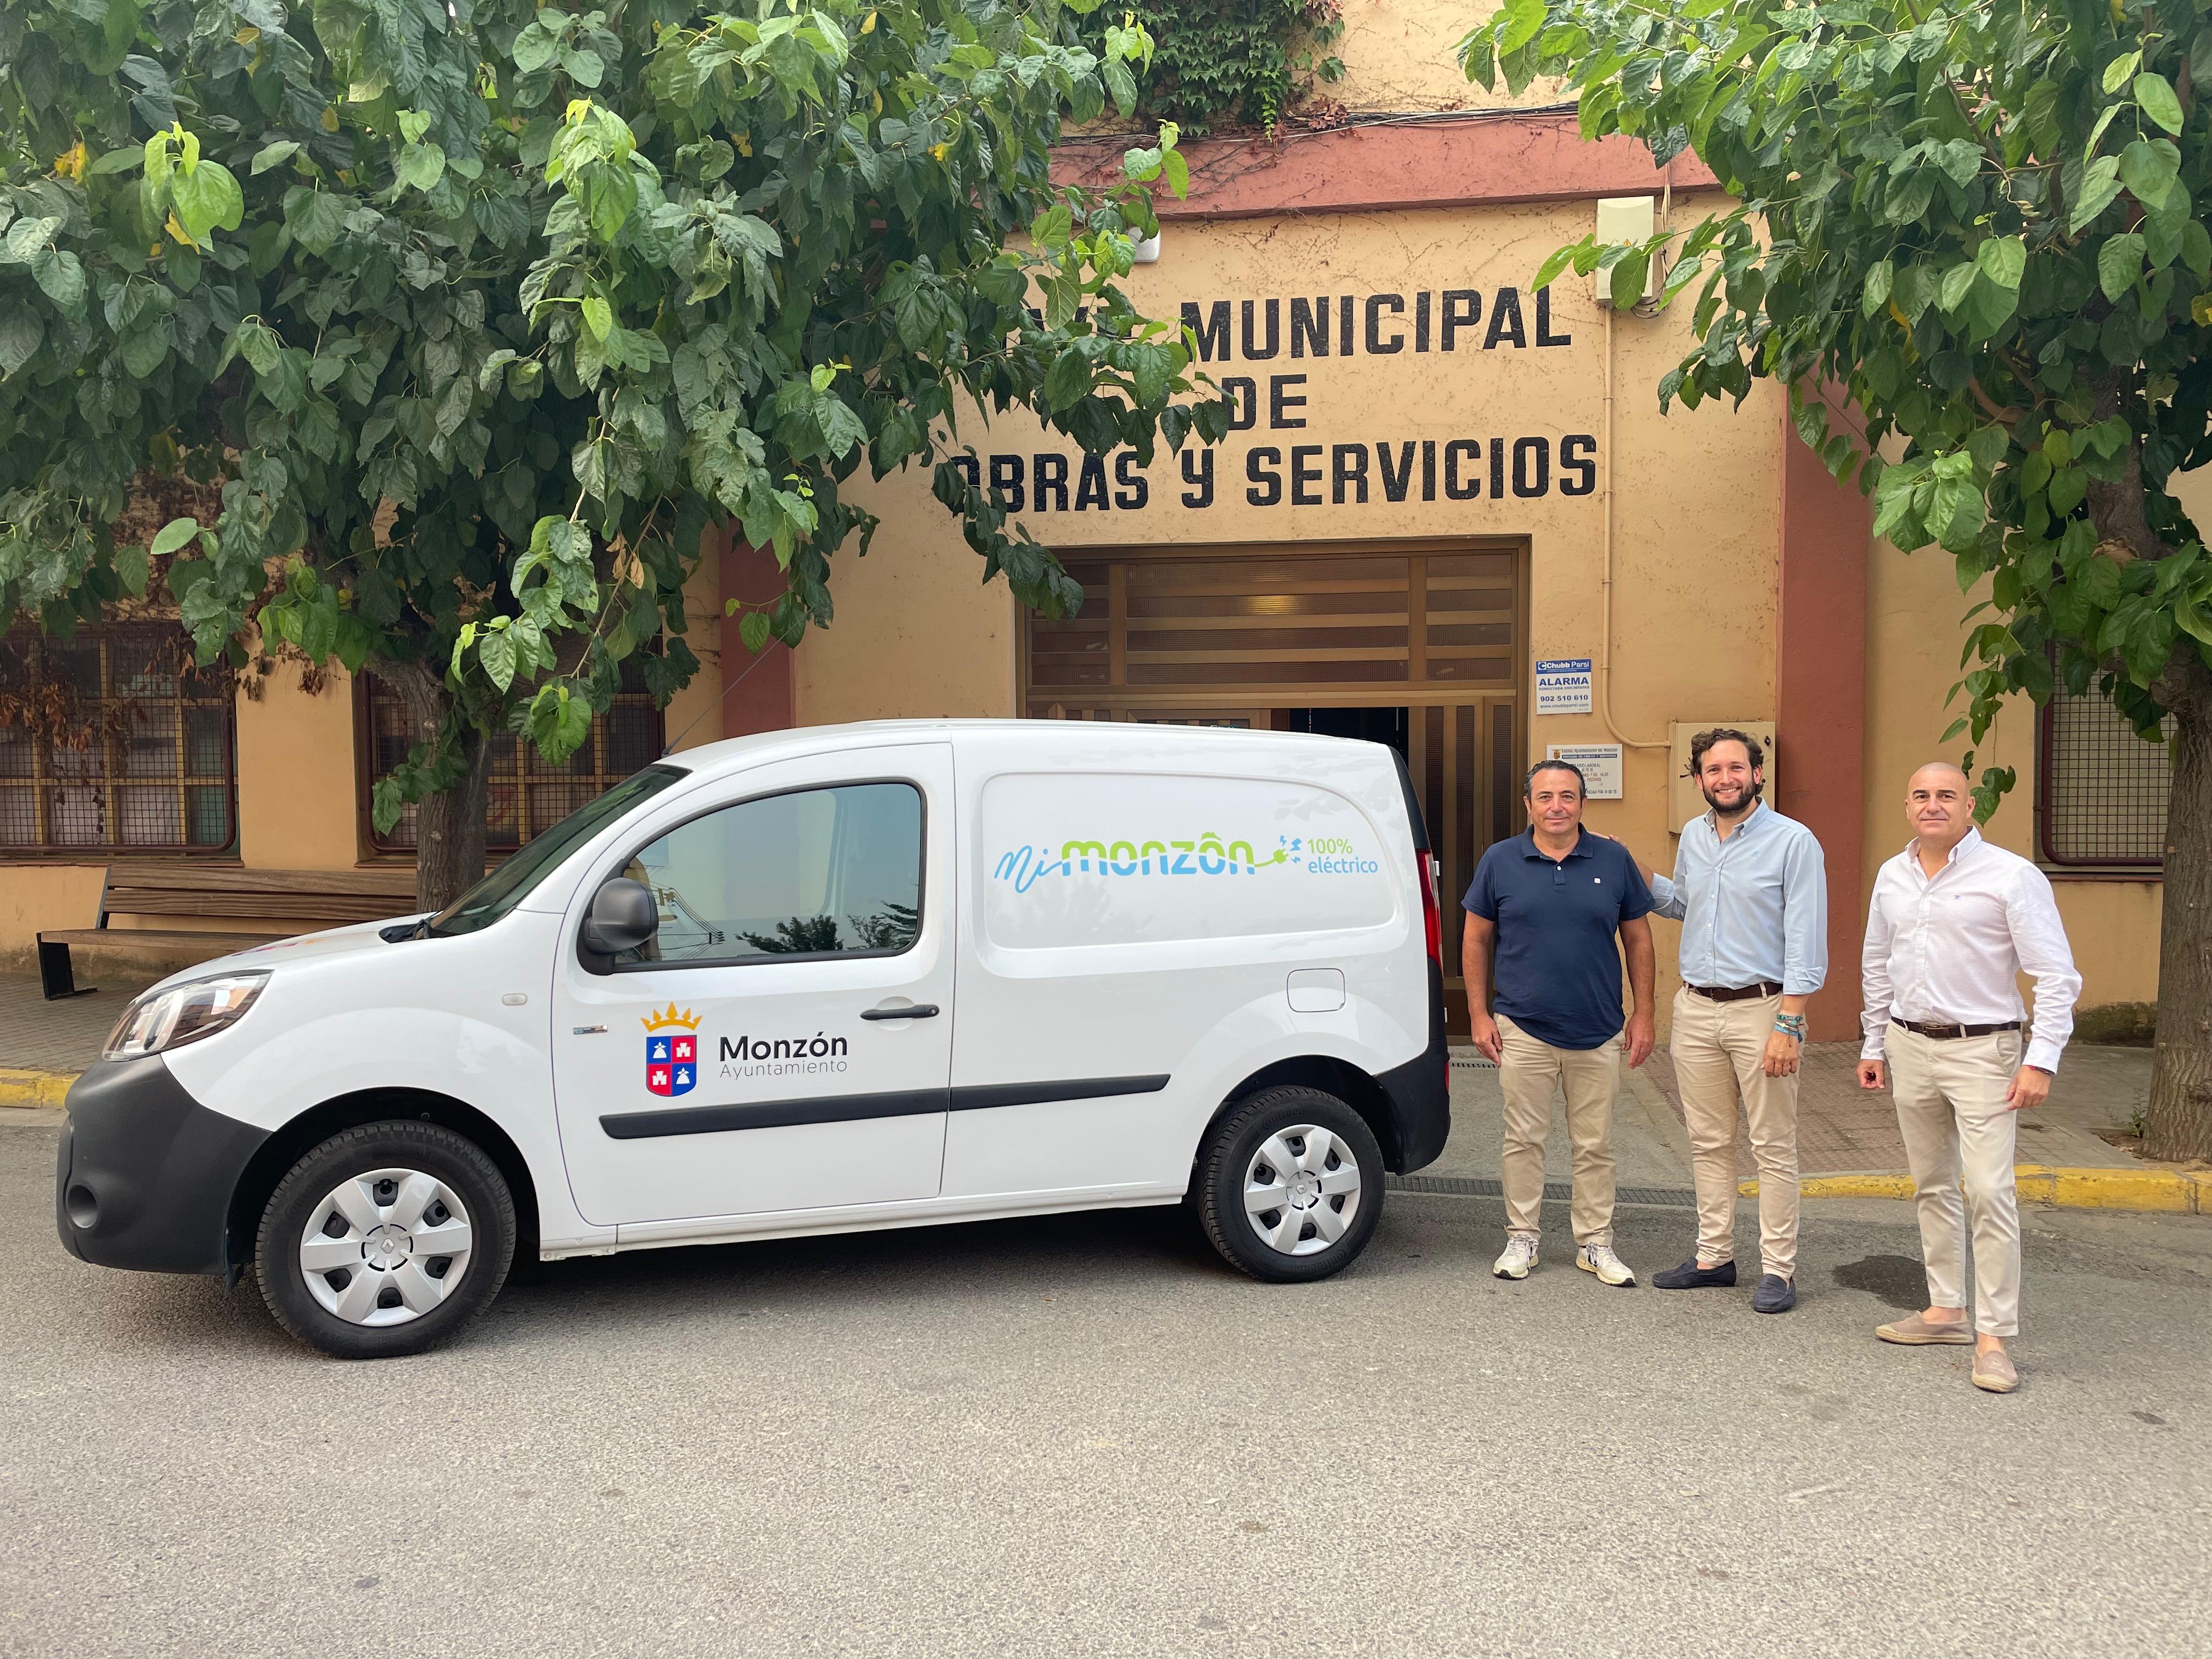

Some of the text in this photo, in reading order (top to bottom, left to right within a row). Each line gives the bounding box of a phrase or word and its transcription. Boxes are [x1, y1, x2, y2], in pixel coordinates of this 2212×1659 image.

[1181, 286, 1571, 362] MUNICIPAL
[1222, 374, 1307, 430] DE
[951, 450, 1148, 514] OBRAS
[1246, 434, 1597, 506] SERVICIOS
[1539, 676, 1589, 686] ALARMA
[1307, 838, 1353, 855] 100%
[1308, 855, 1378, 874] eléctrico
[719, 1031, 848, 1062] Monzón
[719, 1060, 848, 1080] Ayuntamiento
